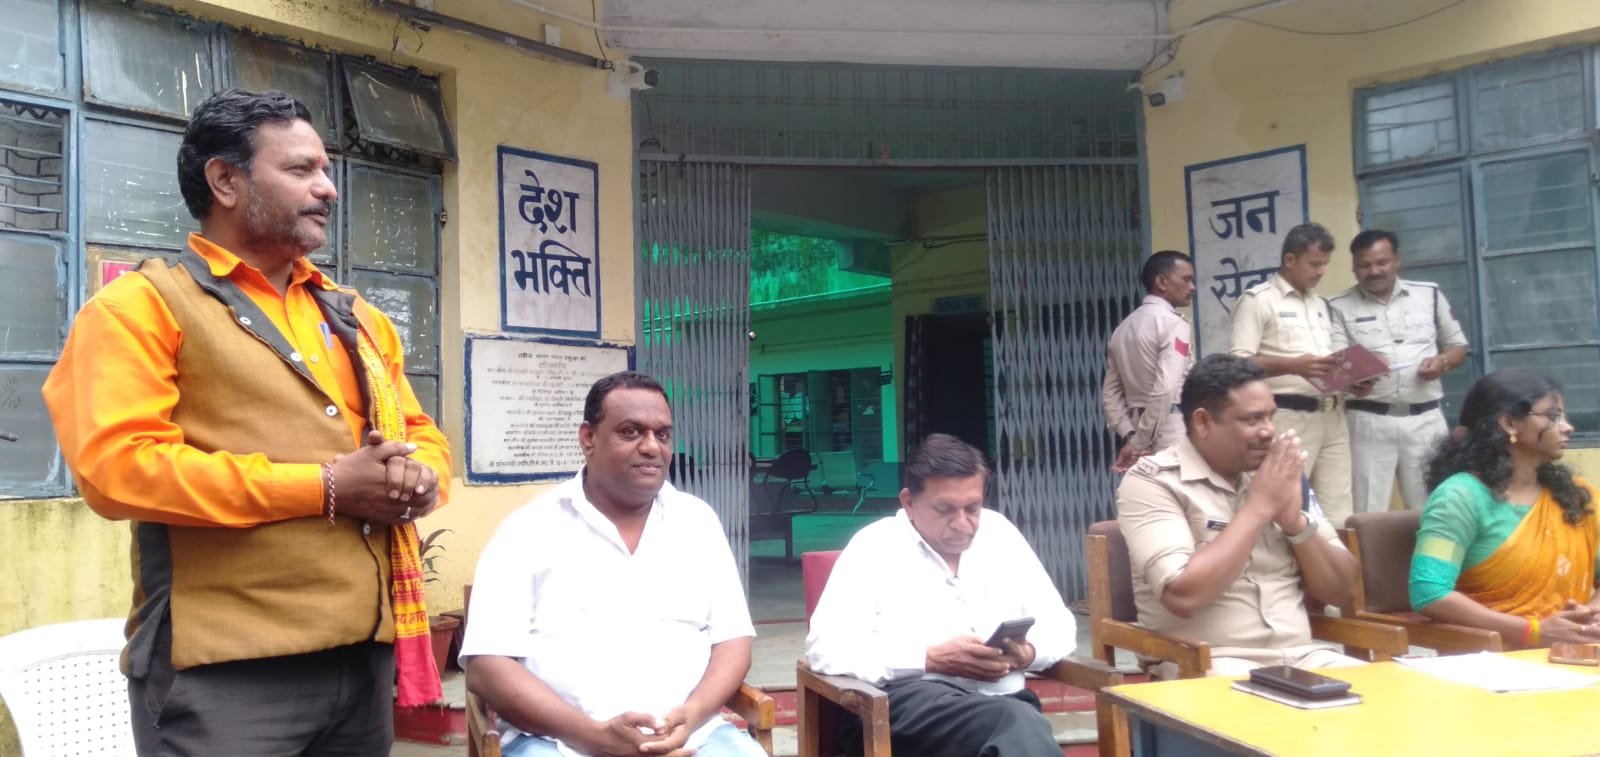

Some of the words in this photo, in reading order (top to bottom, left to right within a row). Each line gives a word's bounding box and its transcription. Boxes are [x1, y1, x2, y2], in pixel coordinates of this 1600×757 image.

[518, 169, 580, 234] देश
[1208, 190, 1280, 240] जन
[511, 239, 592, 298] भक्ति
